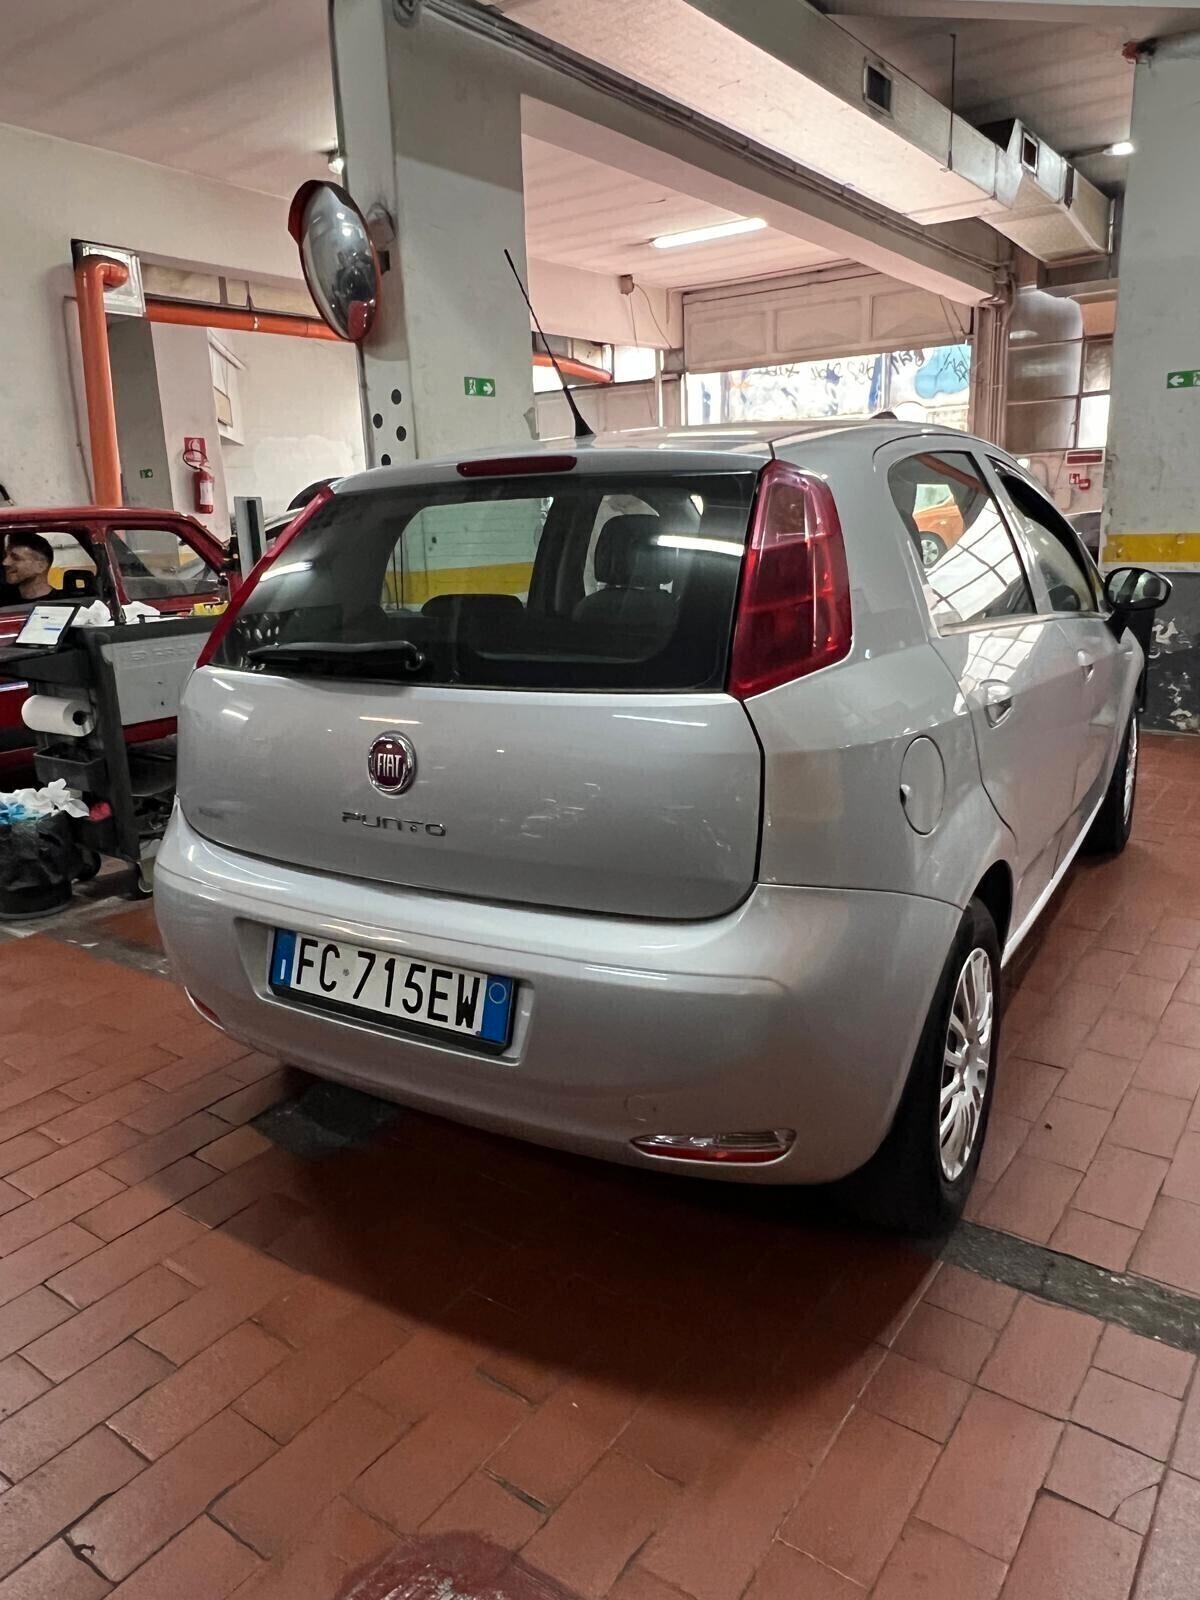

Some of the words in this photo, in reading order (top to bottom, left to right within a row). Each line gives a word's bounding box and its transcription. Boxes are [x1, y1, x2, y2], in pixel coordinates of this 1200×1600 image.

[377, 753, 402, 778] FIAT
[341, 811, 447, 837] PUNTO
[296, 937, 341, 993] FC
[352, 950, 481, 1029] 715EW
